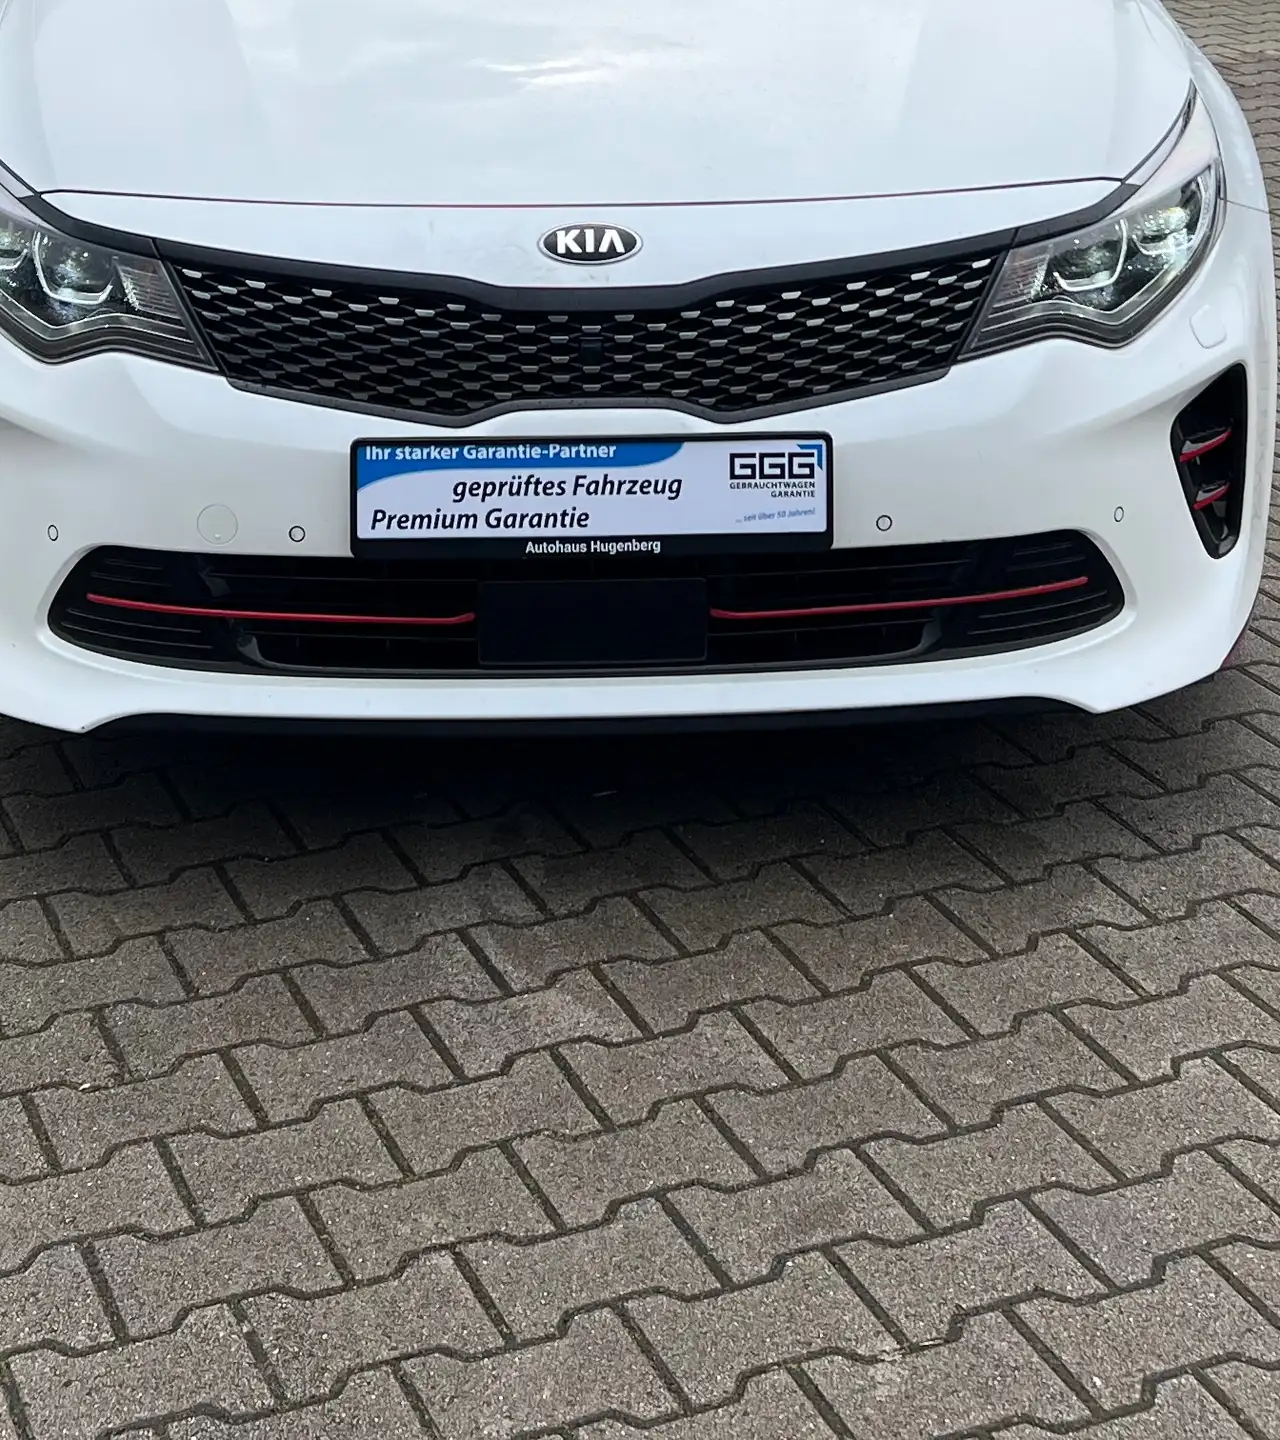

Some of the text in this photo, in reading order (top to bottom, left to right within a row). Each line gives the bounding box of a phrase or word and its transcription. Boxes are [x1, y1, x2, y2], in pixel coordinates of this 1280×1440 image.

[555, 228, 626, 254] KIA
[365, 443, 616, 460] Ihr starker Garantie-Partner
[729, 452, 816, 480] GGG
[452, 473, 683, 502] geprüftes Fahrzeug
[729, 480, 816, 490] GEBRAUCHTWAGEN
[770, 490, 816, 498] GARANTIE
[370, 505, 590, 531] Premium Garantie
[525, 539, 661, 555] Autohaus Hugenberg
